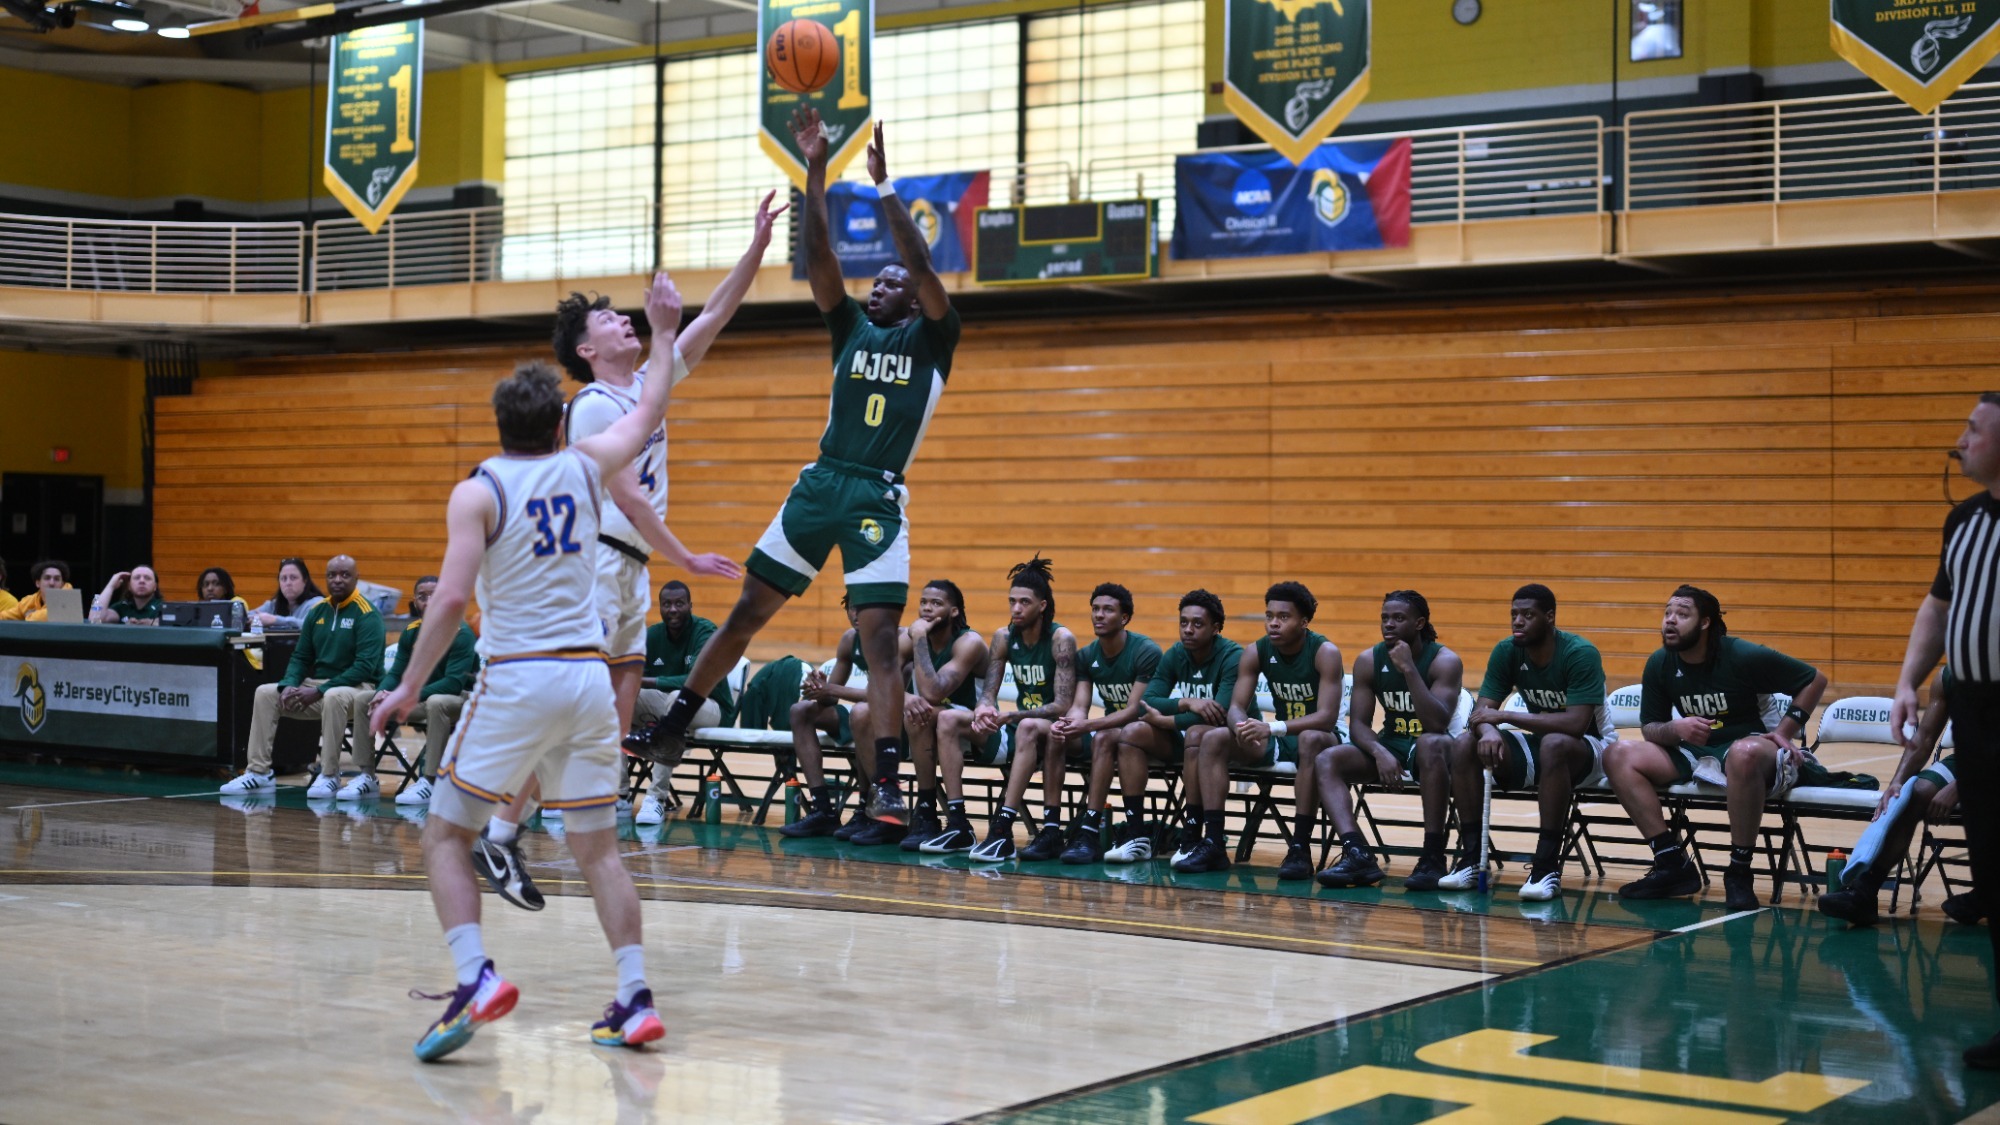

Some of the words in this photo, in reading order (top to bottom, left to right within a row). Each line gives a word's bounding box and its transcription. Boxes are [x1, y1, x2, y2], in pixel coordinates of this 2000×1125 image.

[1875, 7, 1930, 22] DIVISION
[1933, 6, 1942, 17] I,
[1945, 4, 1958, 15] II,
[1961, 2, 1976, 13] III
[1253, 48, 1296, 60] WOMEN'S
[1298, 42, 1343, 55] BOWLING
[1292, 57, 1322, 68] PLACE
[1259, 71, 1300, 82] DIVISION
[1225, 216, 1266, 231] Division
[850, 350, 912, 383] NJCU
[864, 393, 886, 427] 0
[639, 453, 656, 492] 4
[527, 494, 581, 557] 32
[53, 681, 190, 708] #JerseyCitysTeam
[1272, 682, 1314, 701] NJCU
[1524, 688, 1567, 709] NJCU
[1611, 694, 1640, 707] JERS
[1383, 691, 1415, 713] NJC
[1680, 692, 1728, 716] NJCU
[1832, 708, 1877, 722] JERSEY
[709, 788, 719, 799] G
